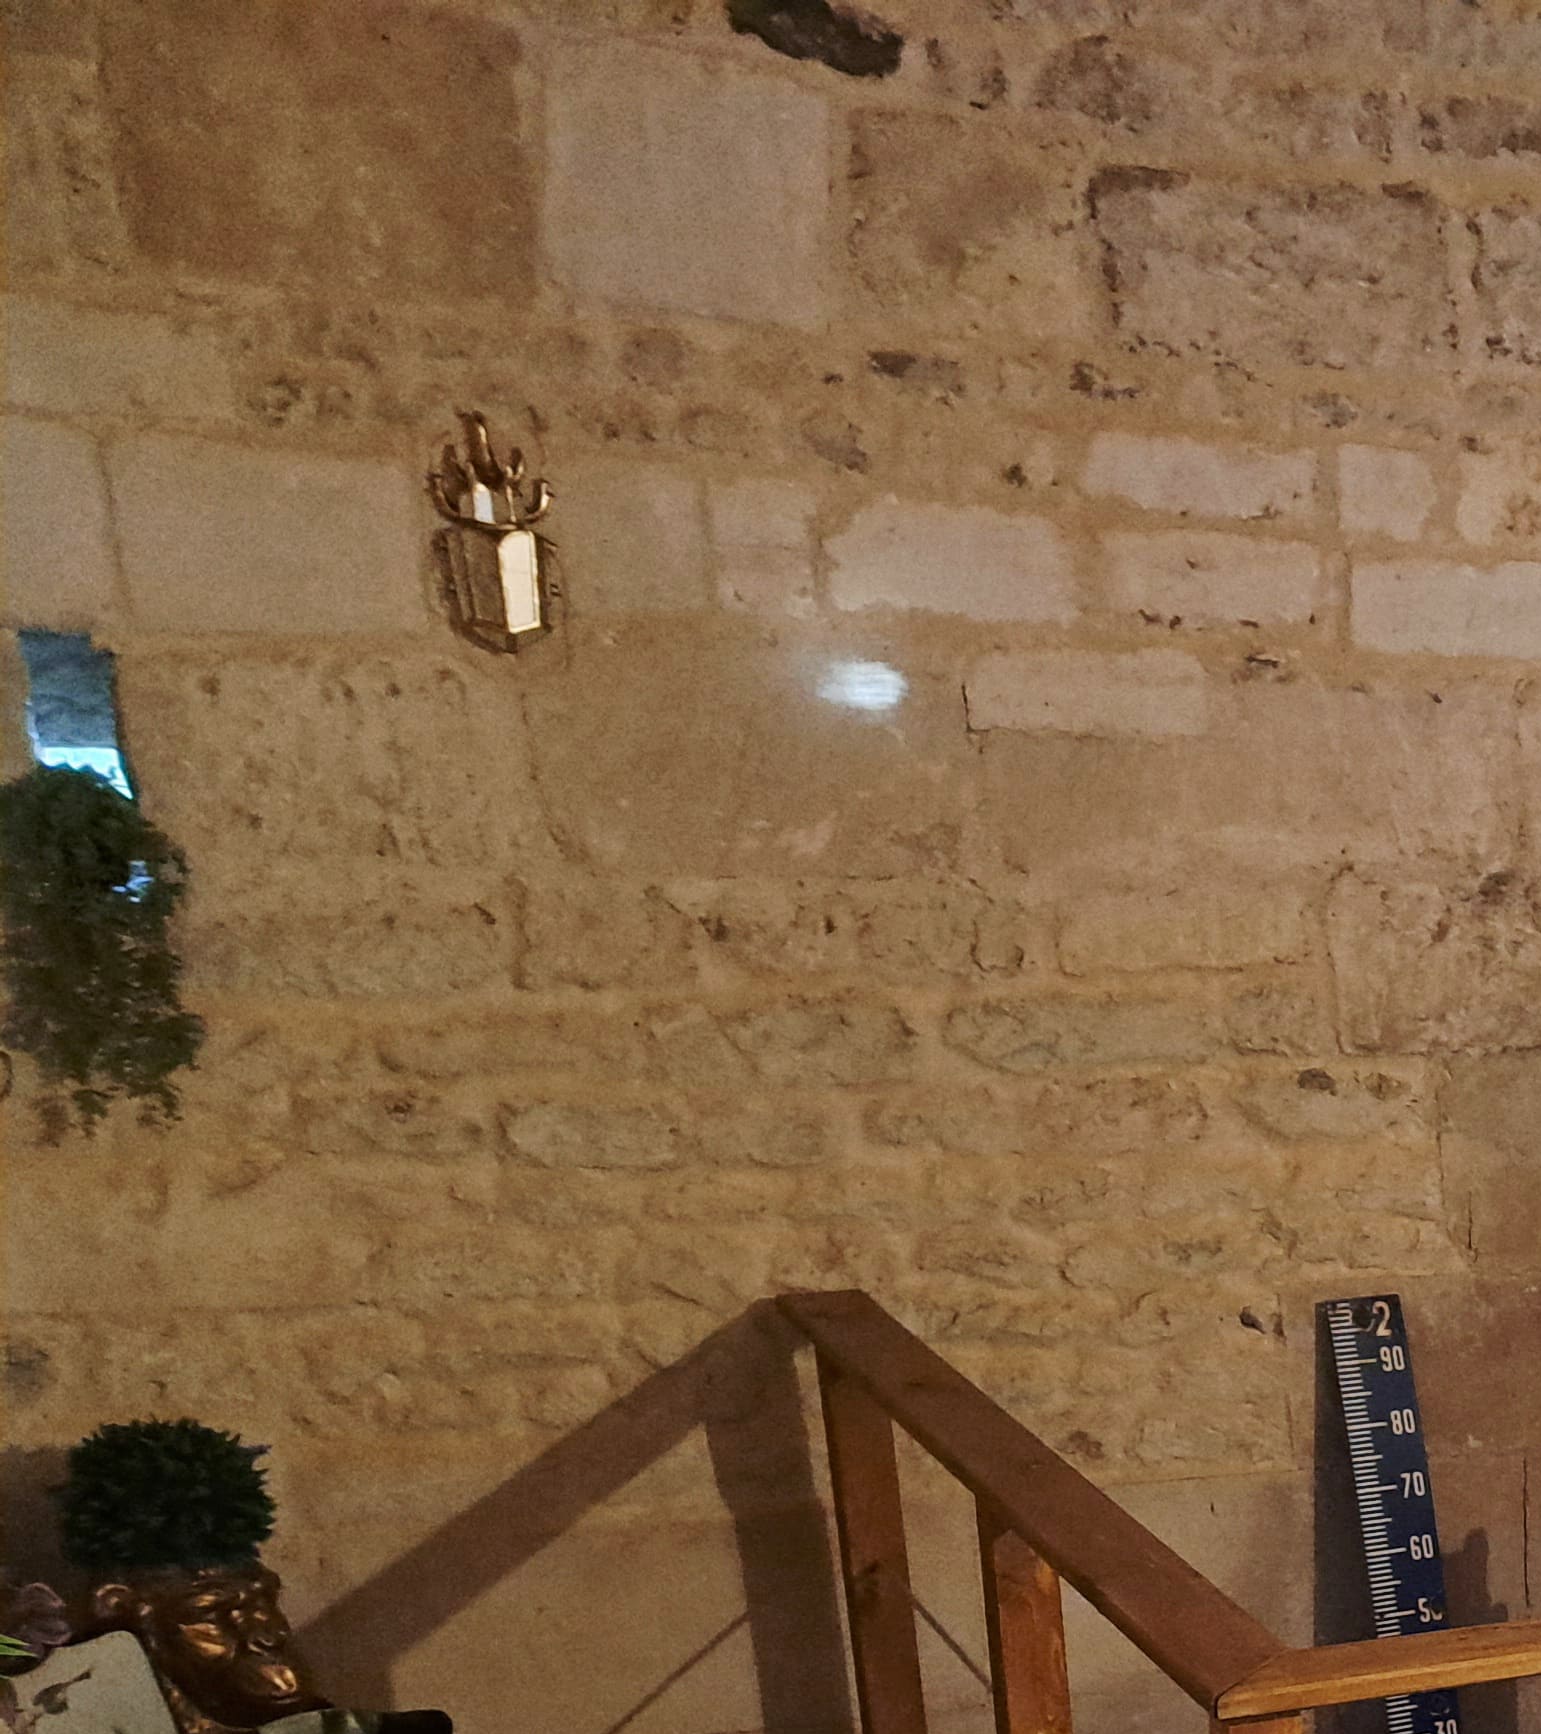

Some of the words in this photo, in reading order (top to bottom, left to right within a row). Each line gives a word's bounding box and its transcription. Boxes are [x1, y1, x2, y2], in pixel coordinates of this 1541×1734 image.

[1373, 1301, 1392, 1336] 2
[1380, 1345, 1405, 1372] 90
[1390, 1409, 1416, 1435] 80
[1400, 1471, 1426, 1498] 70
[1410, 1534, 1434, 1560] 60
